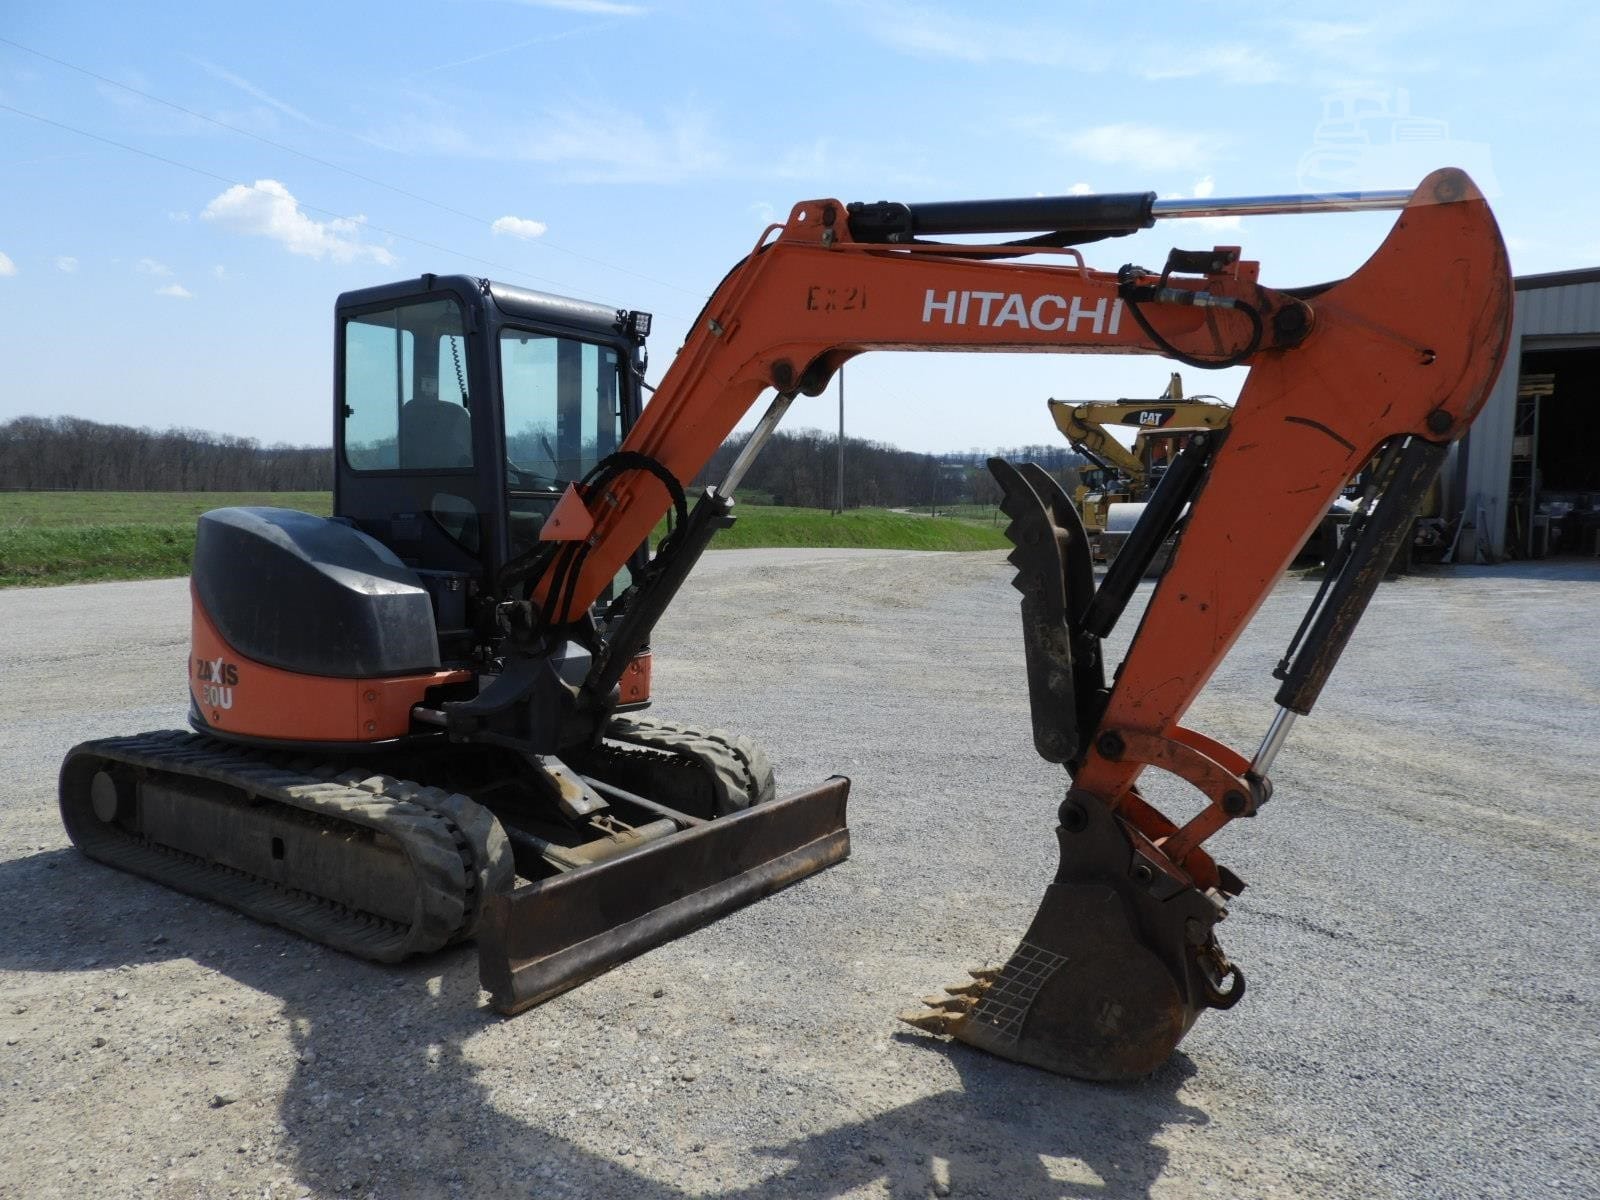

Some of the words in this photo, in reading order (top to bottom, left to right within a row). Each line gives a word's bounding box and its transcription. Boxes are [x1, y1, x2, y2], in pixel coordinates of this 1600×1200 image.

[922, 289, 1125, 335] HITACHI
[1139, 411, 1163, 426] CAT
[196, 657, 239, 686] ZAXIS
